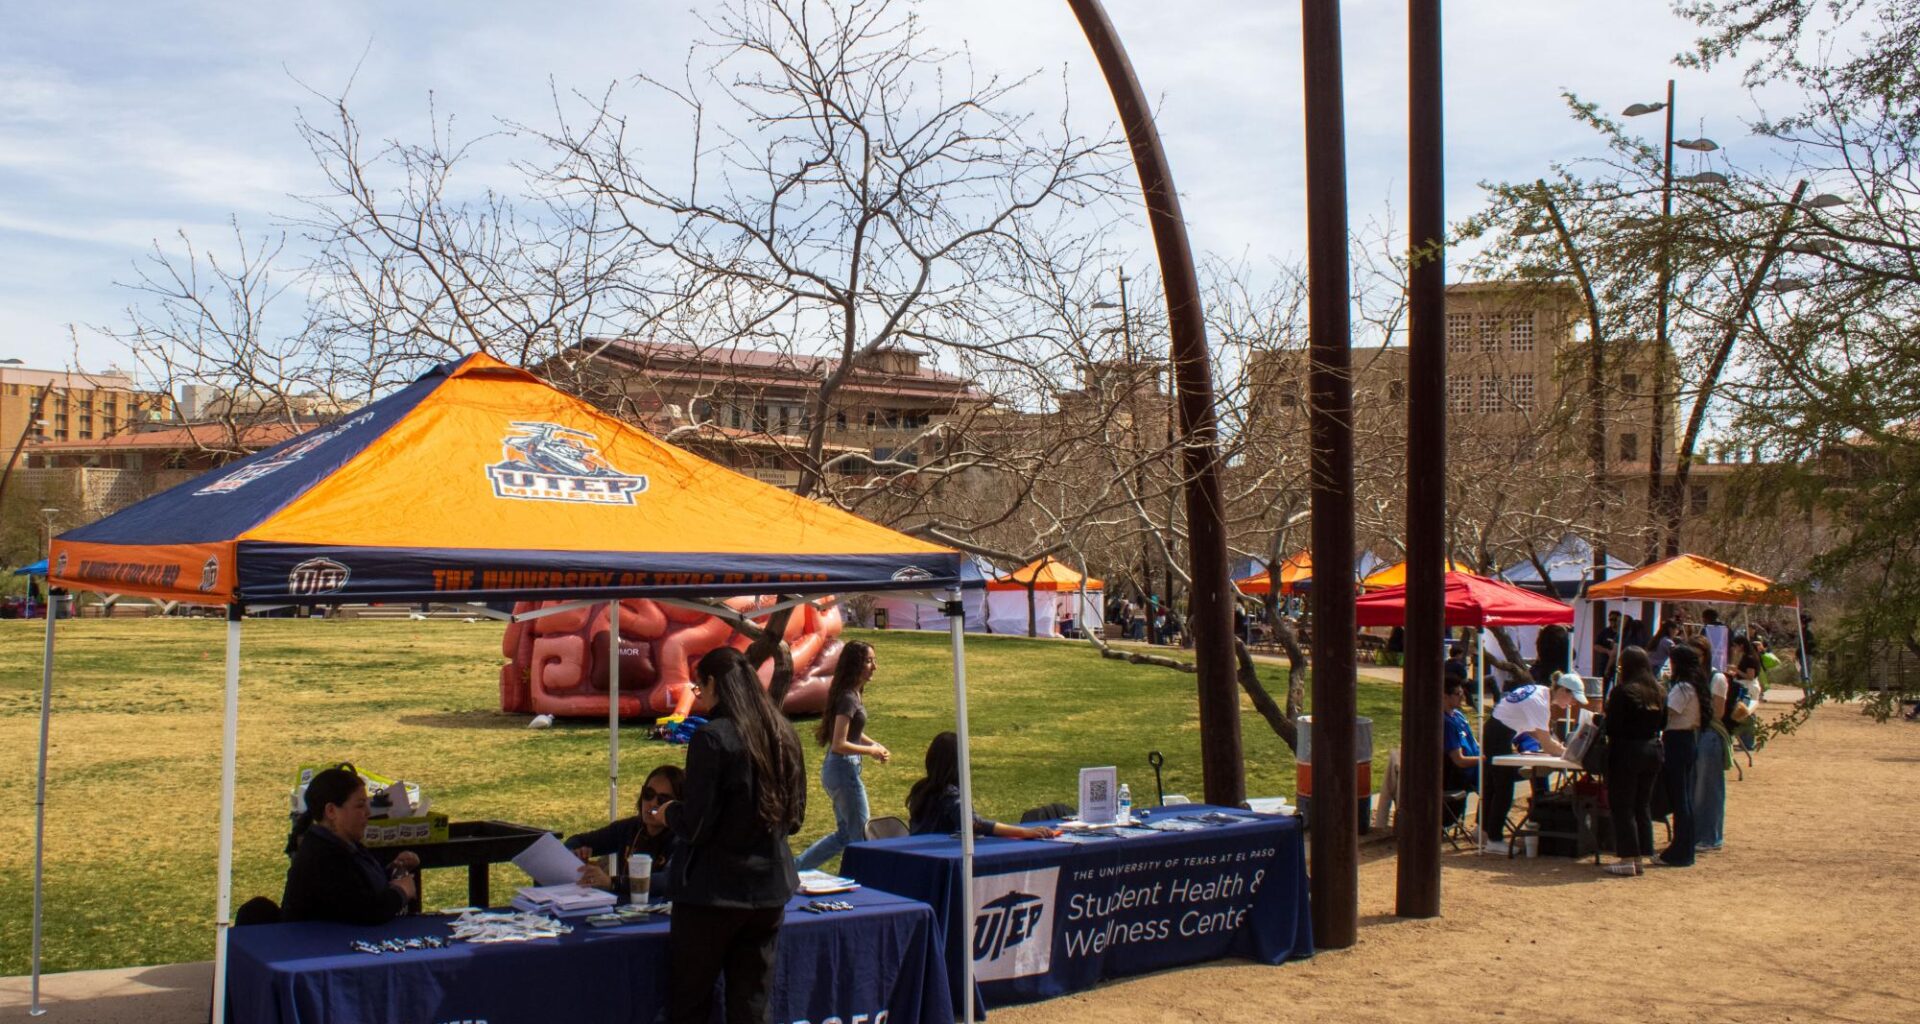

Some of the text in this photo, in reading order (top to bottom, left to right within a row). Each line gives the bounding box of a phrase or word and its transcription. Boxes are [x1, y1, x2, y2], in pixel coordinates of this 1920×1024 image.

[497, 471, 638, 493] UTEP
[503, 487, 624, 501] MINERS
[432, 569, 475, 591] THE
[482, 570, 614, 590] UNIVERSITY
[619, 572, 647, 586] OF
[654, 572, 715, 585] TEXAS
[723, 572, 745, 584] AT
[1073, 848, 1275, 881] THE UNIVERSITY OF TEXAS AT EL PASO
[1067, 882, 1163, 921] Student
[1169, 873, 1244, 903] Health
[973, 890, 1043, 961] UTEP
[1064, 903, 1253, 959] Wellness Cente
